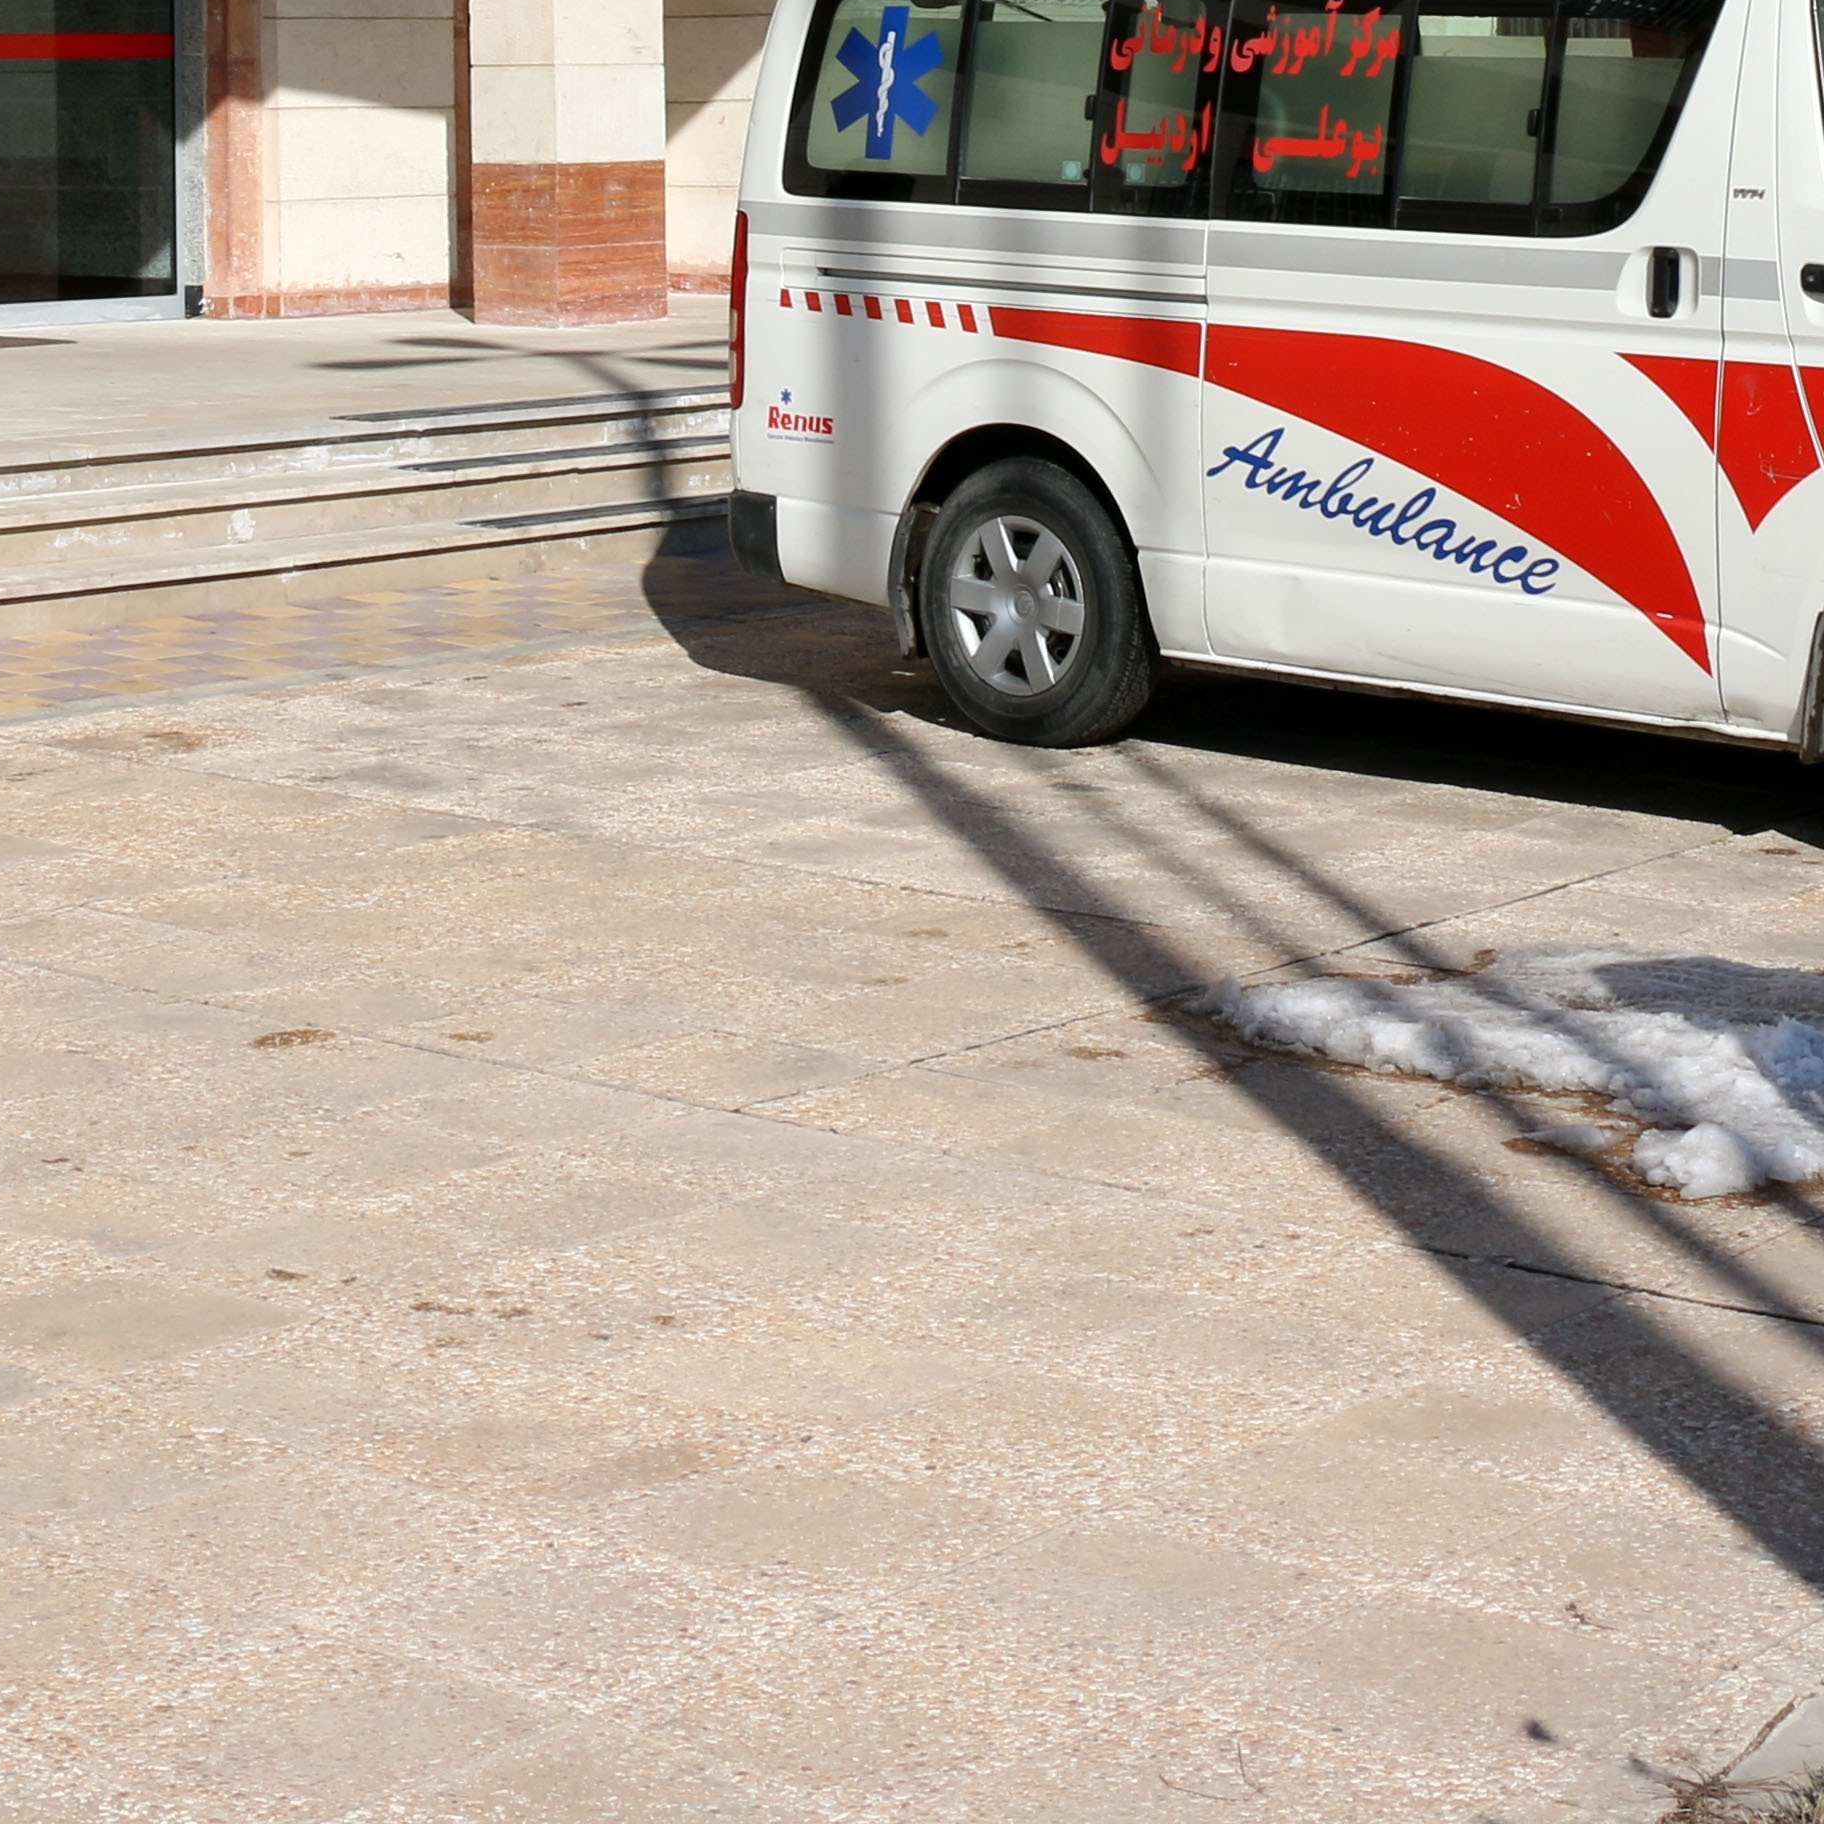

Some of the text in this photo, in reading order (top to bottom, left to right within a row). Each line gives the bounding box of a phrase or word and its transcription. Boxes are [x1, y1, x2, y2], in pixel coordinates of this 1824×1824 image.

[1340, 6, 1401, 77] مرکز
[1100, 97, 1383, 178] بوعلی اردبیل
[768, 405, 834, 435] Renus
[1207, 427, 1560, 595] Ambulance
